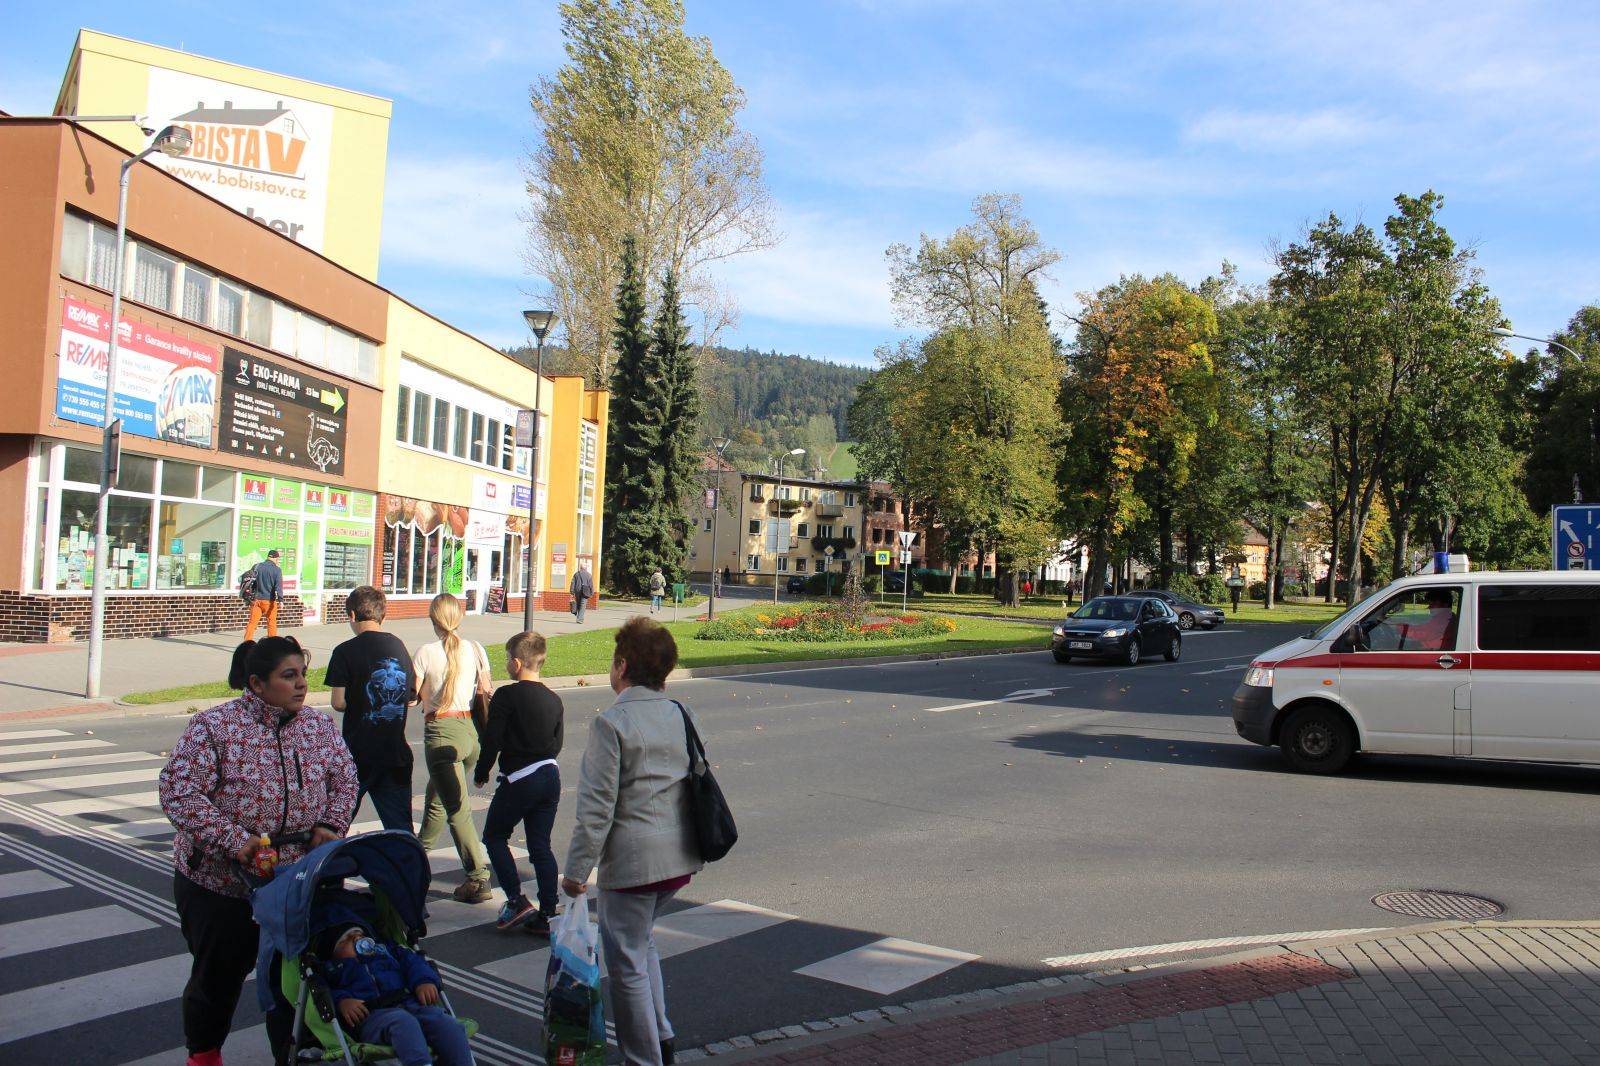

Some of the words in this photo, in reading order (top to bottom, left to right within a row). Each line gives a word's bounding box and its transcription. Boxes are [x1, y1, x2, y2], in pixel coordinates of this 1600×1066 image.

[184, 124, 306, 174] BISTAV
[166, 165, 307, 200] www.bobistav.cz
[67, 340, 109, 372] RE/MA
[253, 364, 301, 390] EKO-FARMA
